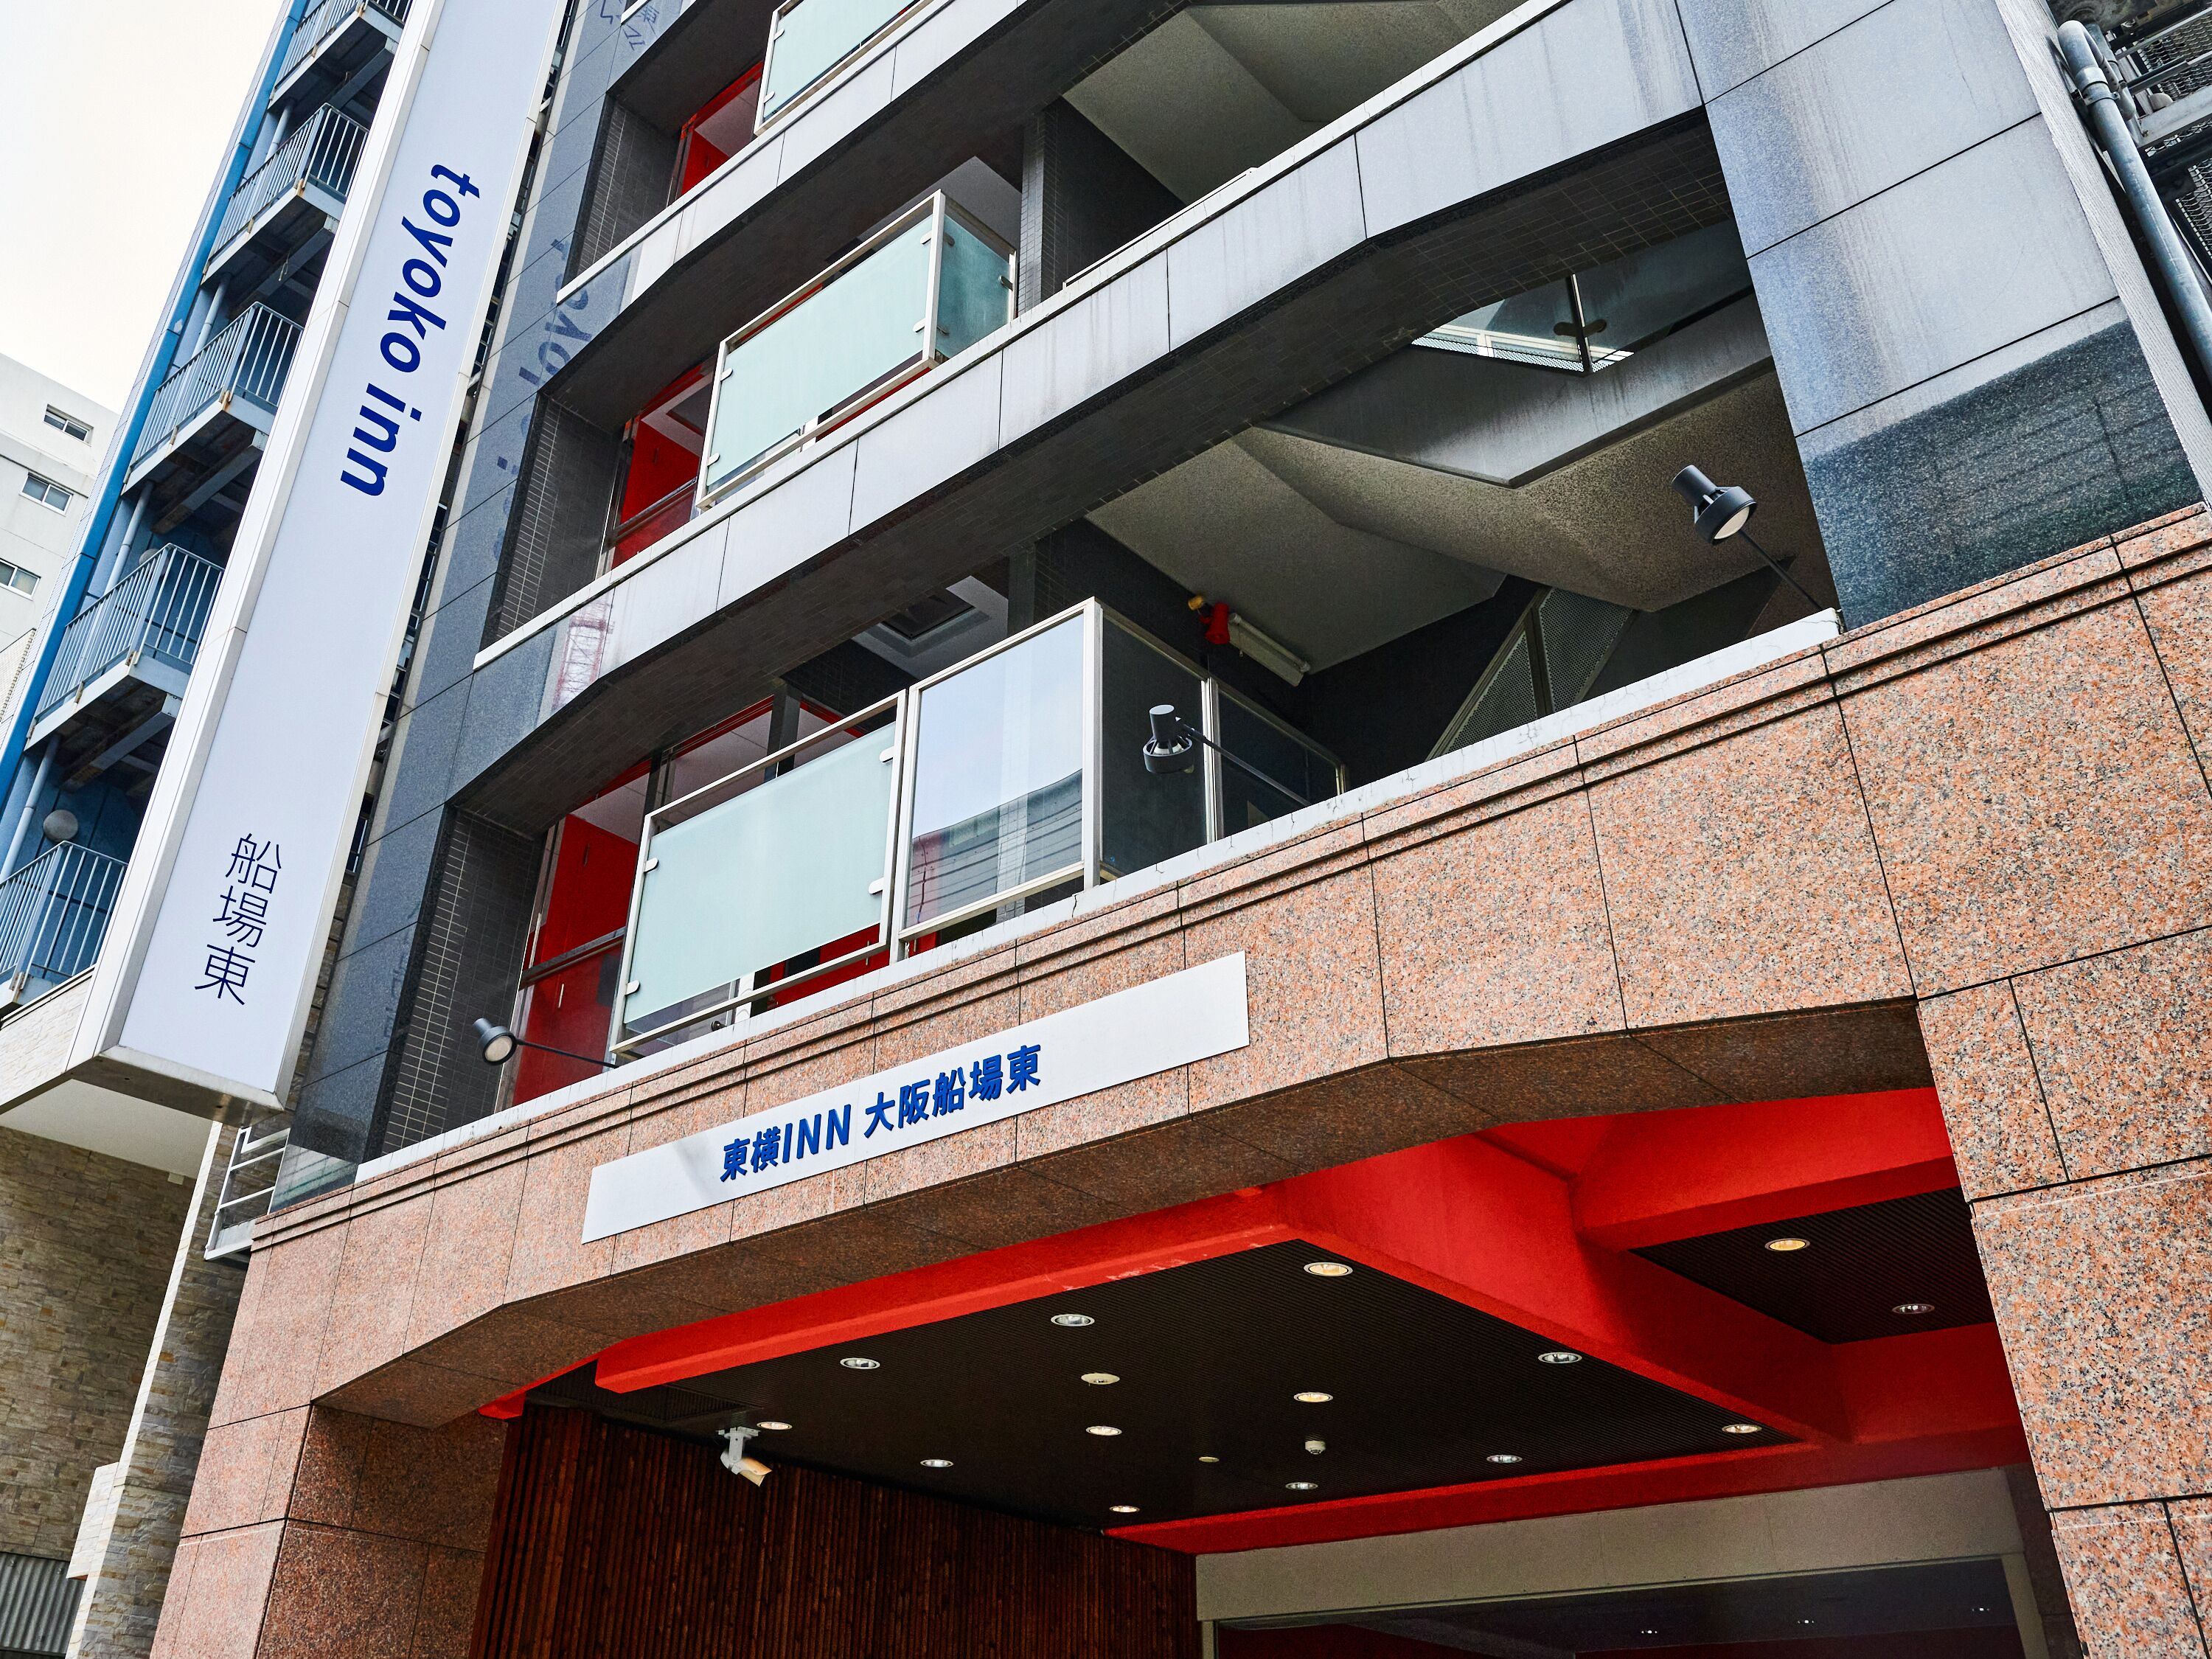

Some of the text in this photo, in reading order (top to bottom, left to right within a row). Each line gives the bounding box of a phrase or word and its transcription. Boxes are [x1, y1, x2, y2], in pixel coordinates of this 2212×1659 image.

[341, 164, 480, 496] toyoko inn
[194, 832, 282, 1006] 船場東
[720, 1044, 1041, 1182] 東横INN 大阪船場東
